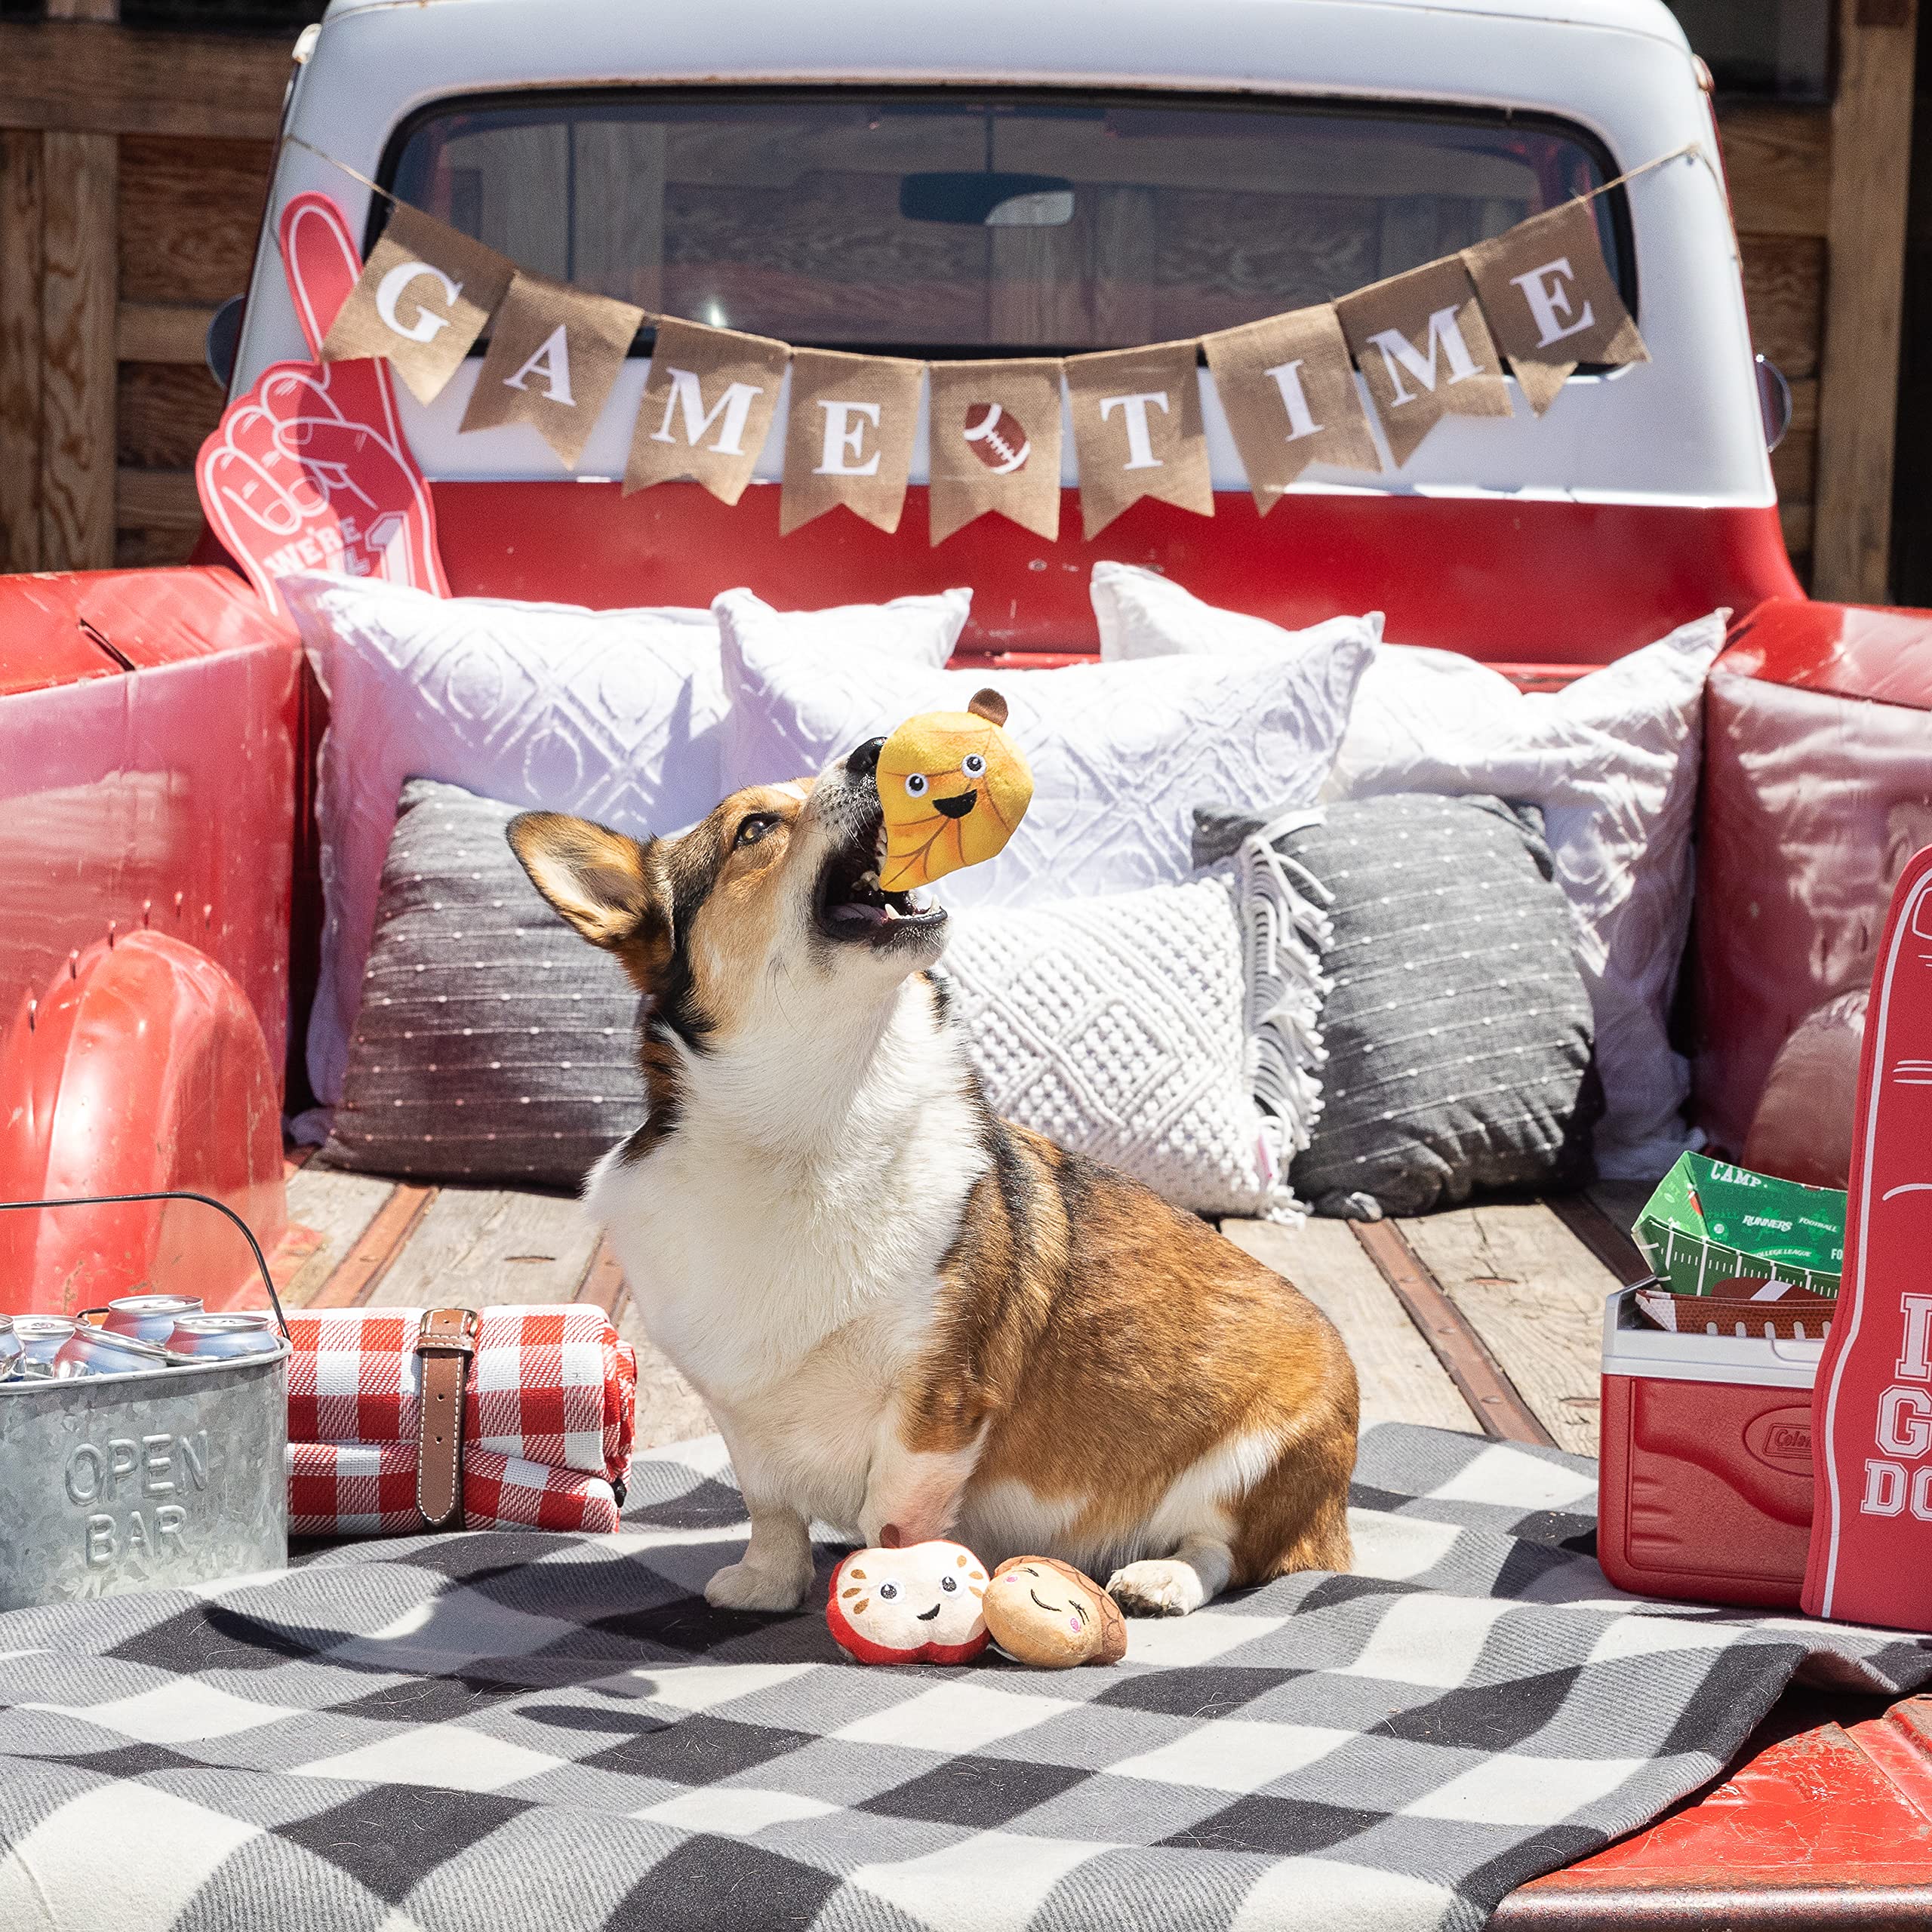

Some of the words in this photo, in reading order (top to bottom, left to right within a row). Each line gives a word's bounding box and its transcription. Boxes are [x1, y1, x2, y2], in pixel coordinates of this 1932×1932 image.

[375, 261, 881, 476] GAME
[1100, 257, 1595, 471] TIME
[1742, 1215, 1793, 1232] RUNNERS
[1798, 1217, 1838, 1232] FOOTBALL
[1784, 1248, 1812, 1257] LEAGUE
[1774, 1429, 1813, 1448] Cole
[64, 1429, 209, 1508] OPEN
[85, 1505, 189, 1570] BAR
